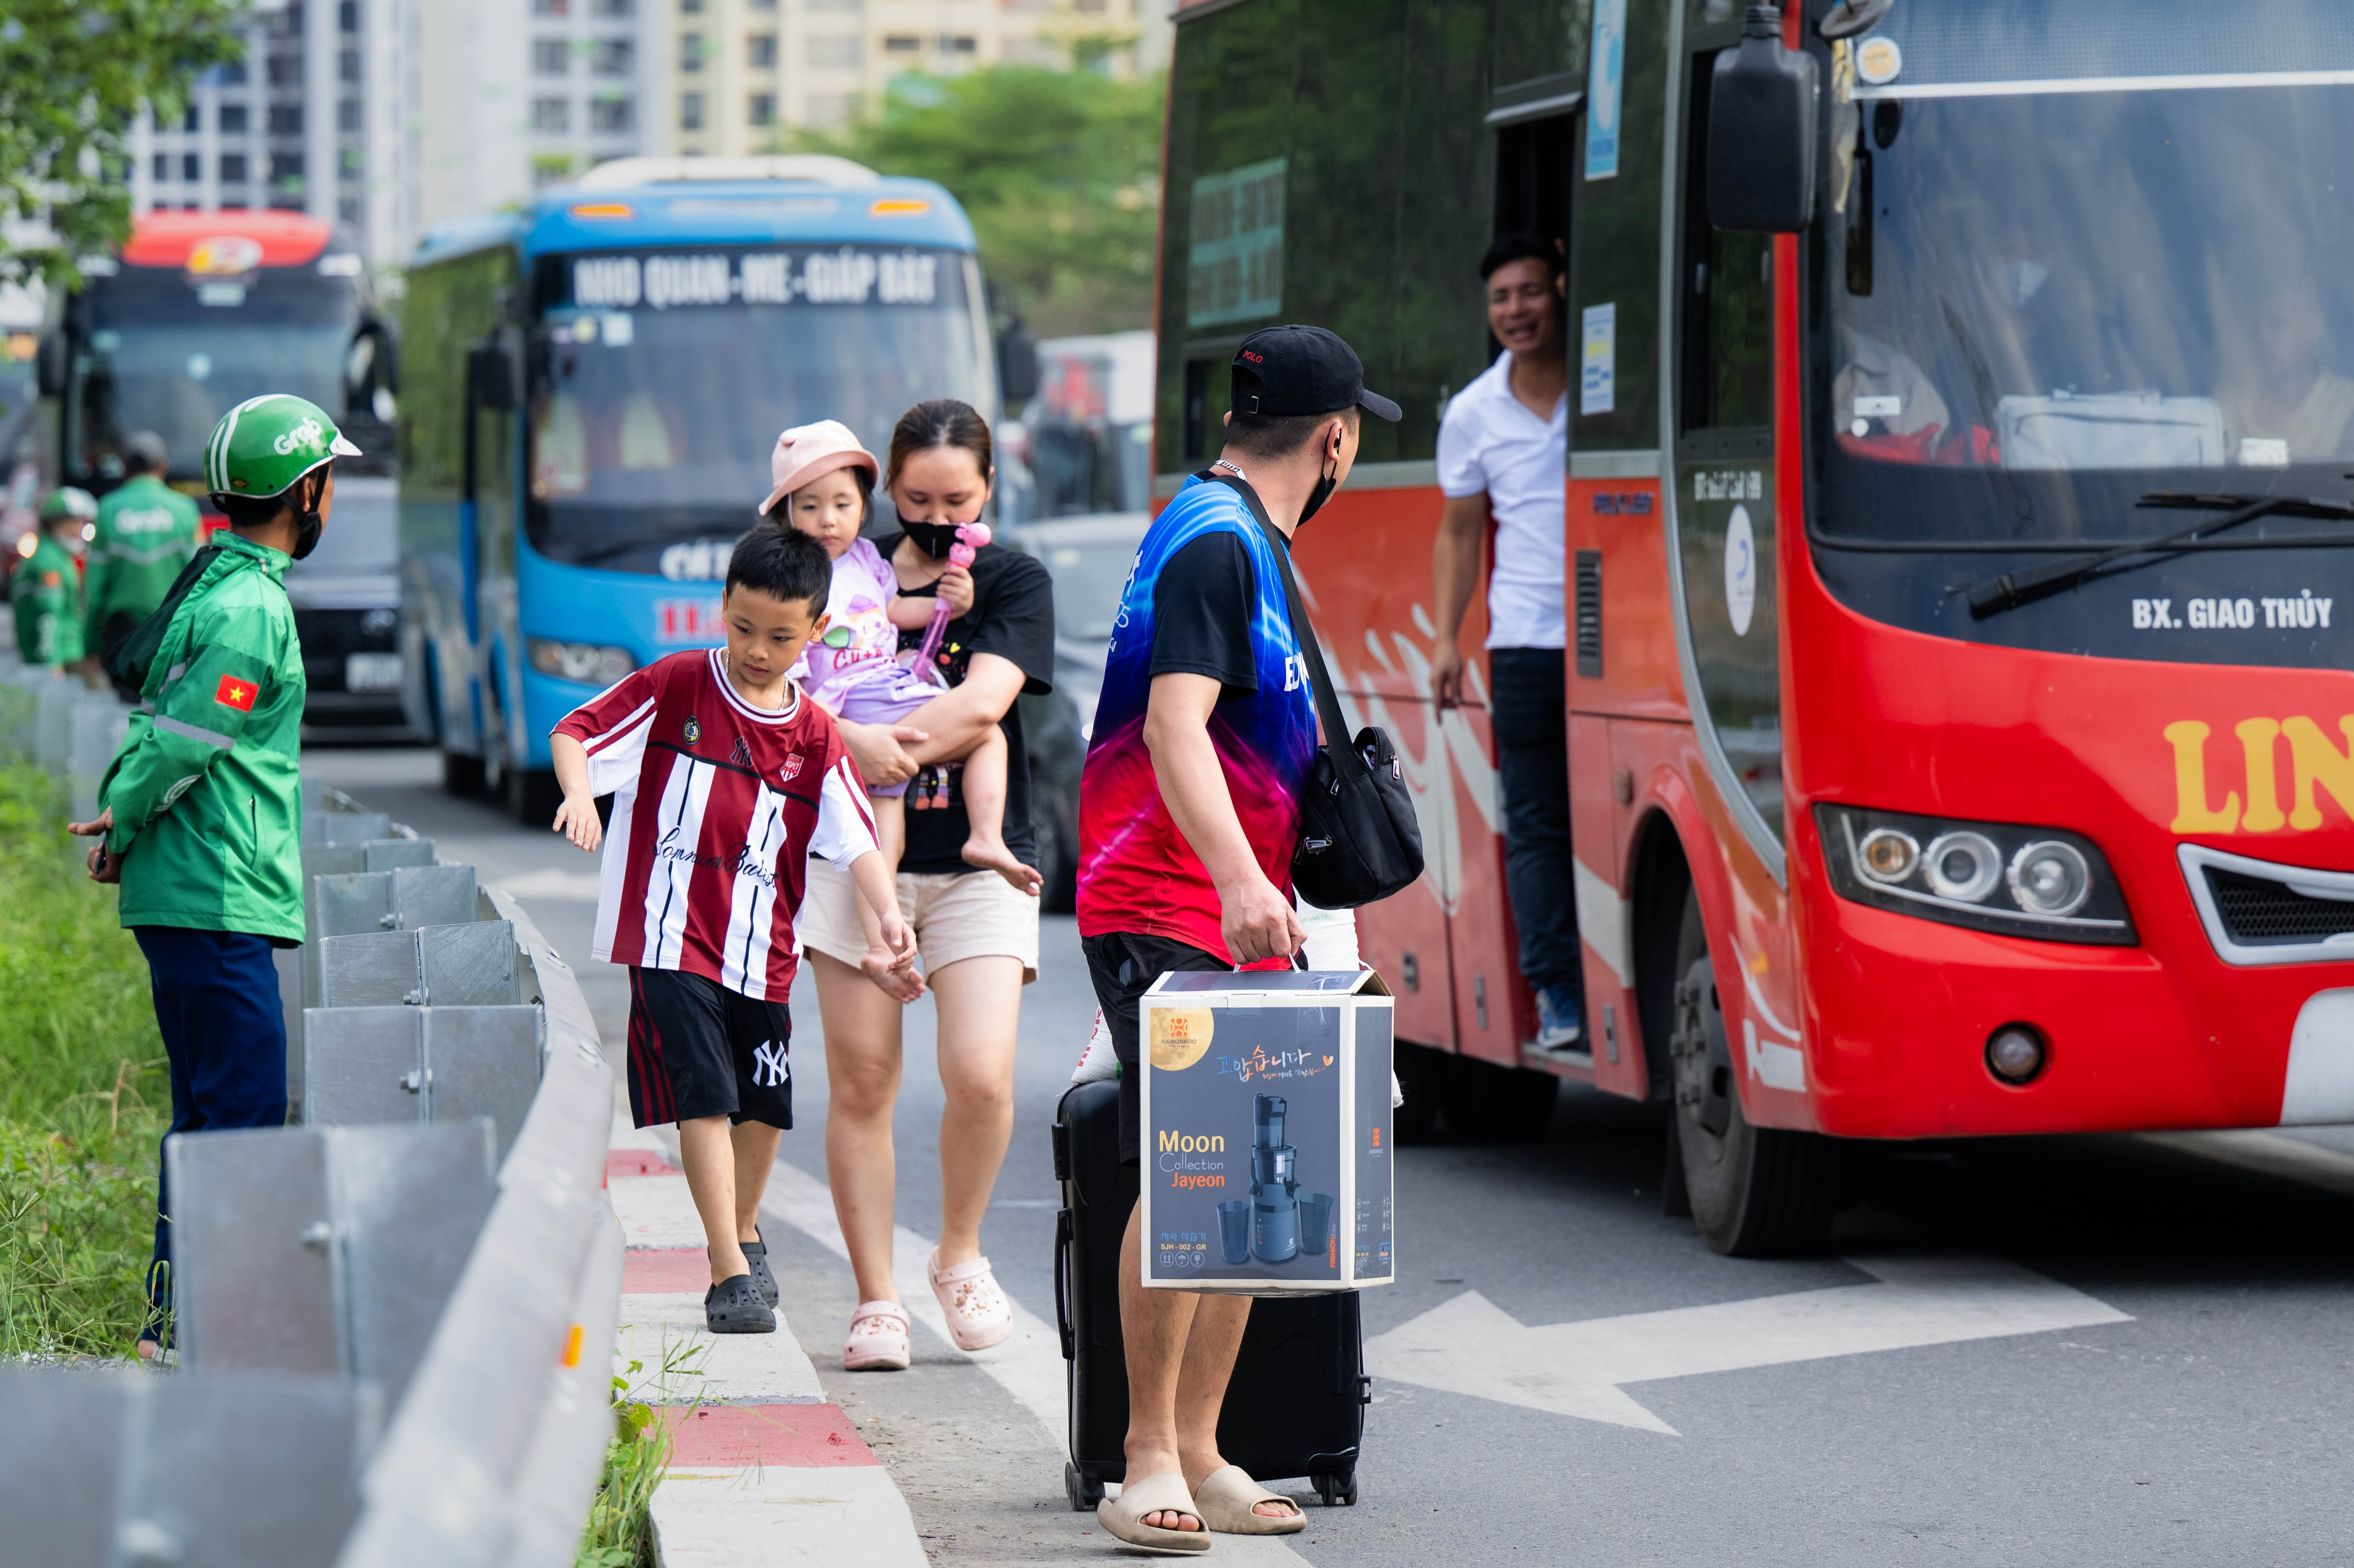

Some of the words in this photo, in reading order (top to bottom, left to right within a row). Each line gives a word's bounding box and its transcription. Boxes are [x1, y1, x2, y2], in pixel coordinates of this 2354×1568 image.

[1243, 350, 1263, 363] POLO
[274, 417, 321, 455] Grab
[2132, 598, 2182, 629] BX.
[2188, 598, 2255, 629] GIAO
[2261, 588, 2333, 628] THỦY
[1159, 1130, 1224, 1152] Moon
[1159, 1152, 1223, 1172] Collection
[1171, 1172, 1225, 1190] Jayeon
